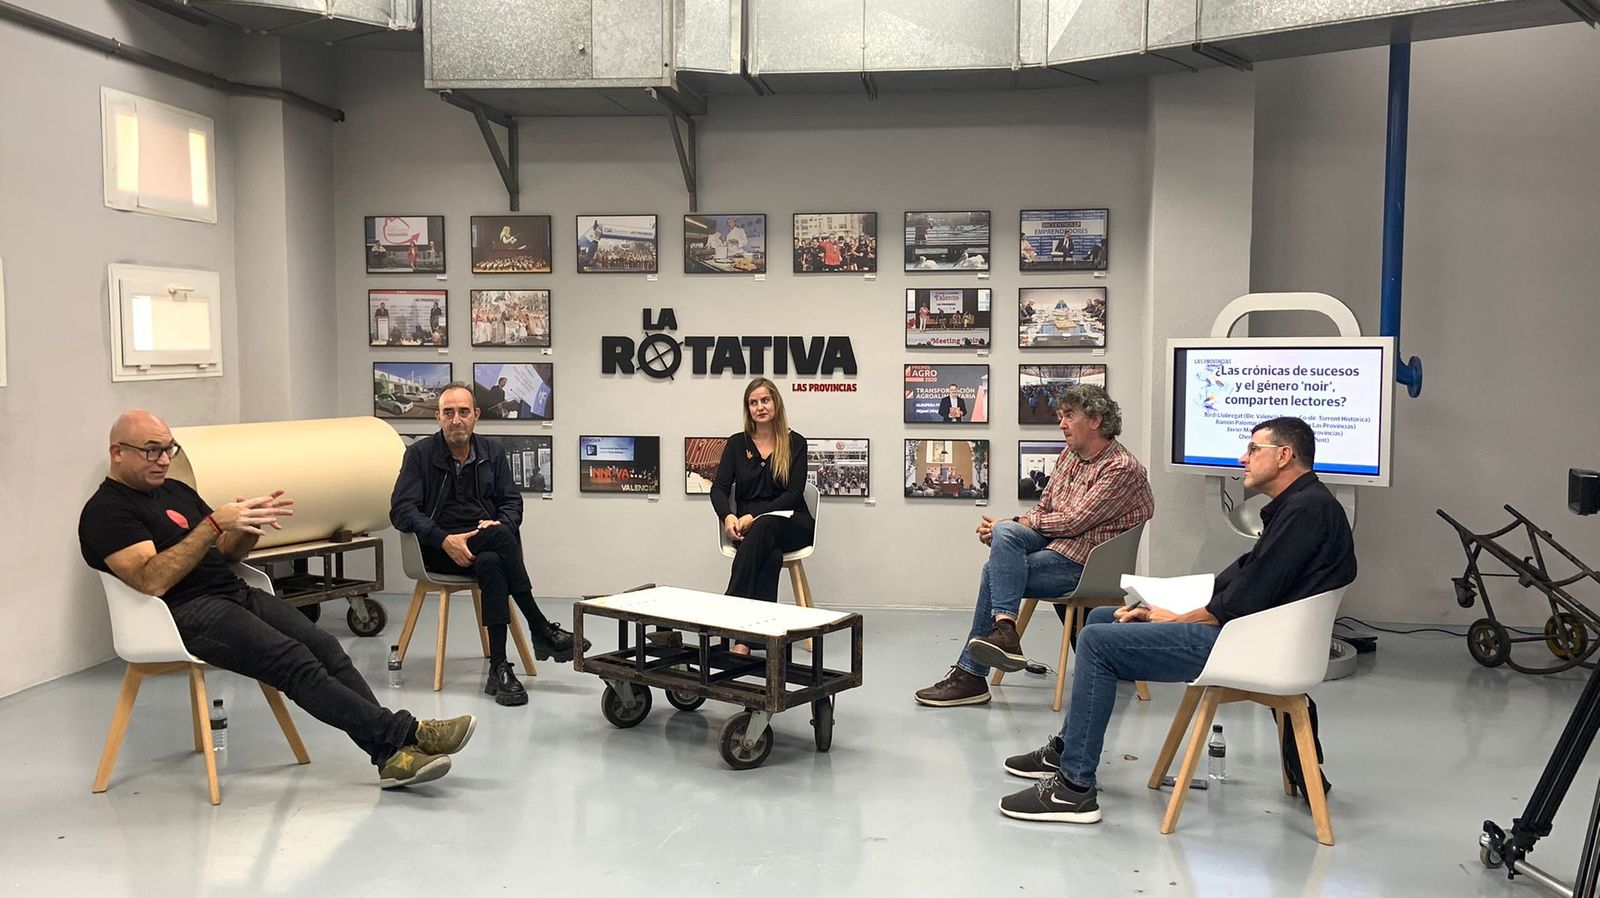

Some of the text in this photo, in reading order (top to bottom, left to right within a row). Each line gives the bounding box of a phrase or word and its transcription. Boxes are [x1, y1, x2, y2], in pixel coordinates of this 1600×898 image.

[643, 308, 678, 330] LA
[601, 333, 858, 378] ROTATIVA
[1215, 365, 1360, 376] ¿Las crónicas de sucesos
[792, 384, 857, 392] LAS PROVINCIAS
[1235, 382, 1242, 392] y
[1244, 380, 1254, 390] el
[1256, 380, 1298, 393] género
[1224, 396, 1347, 407] comparten lectores?
